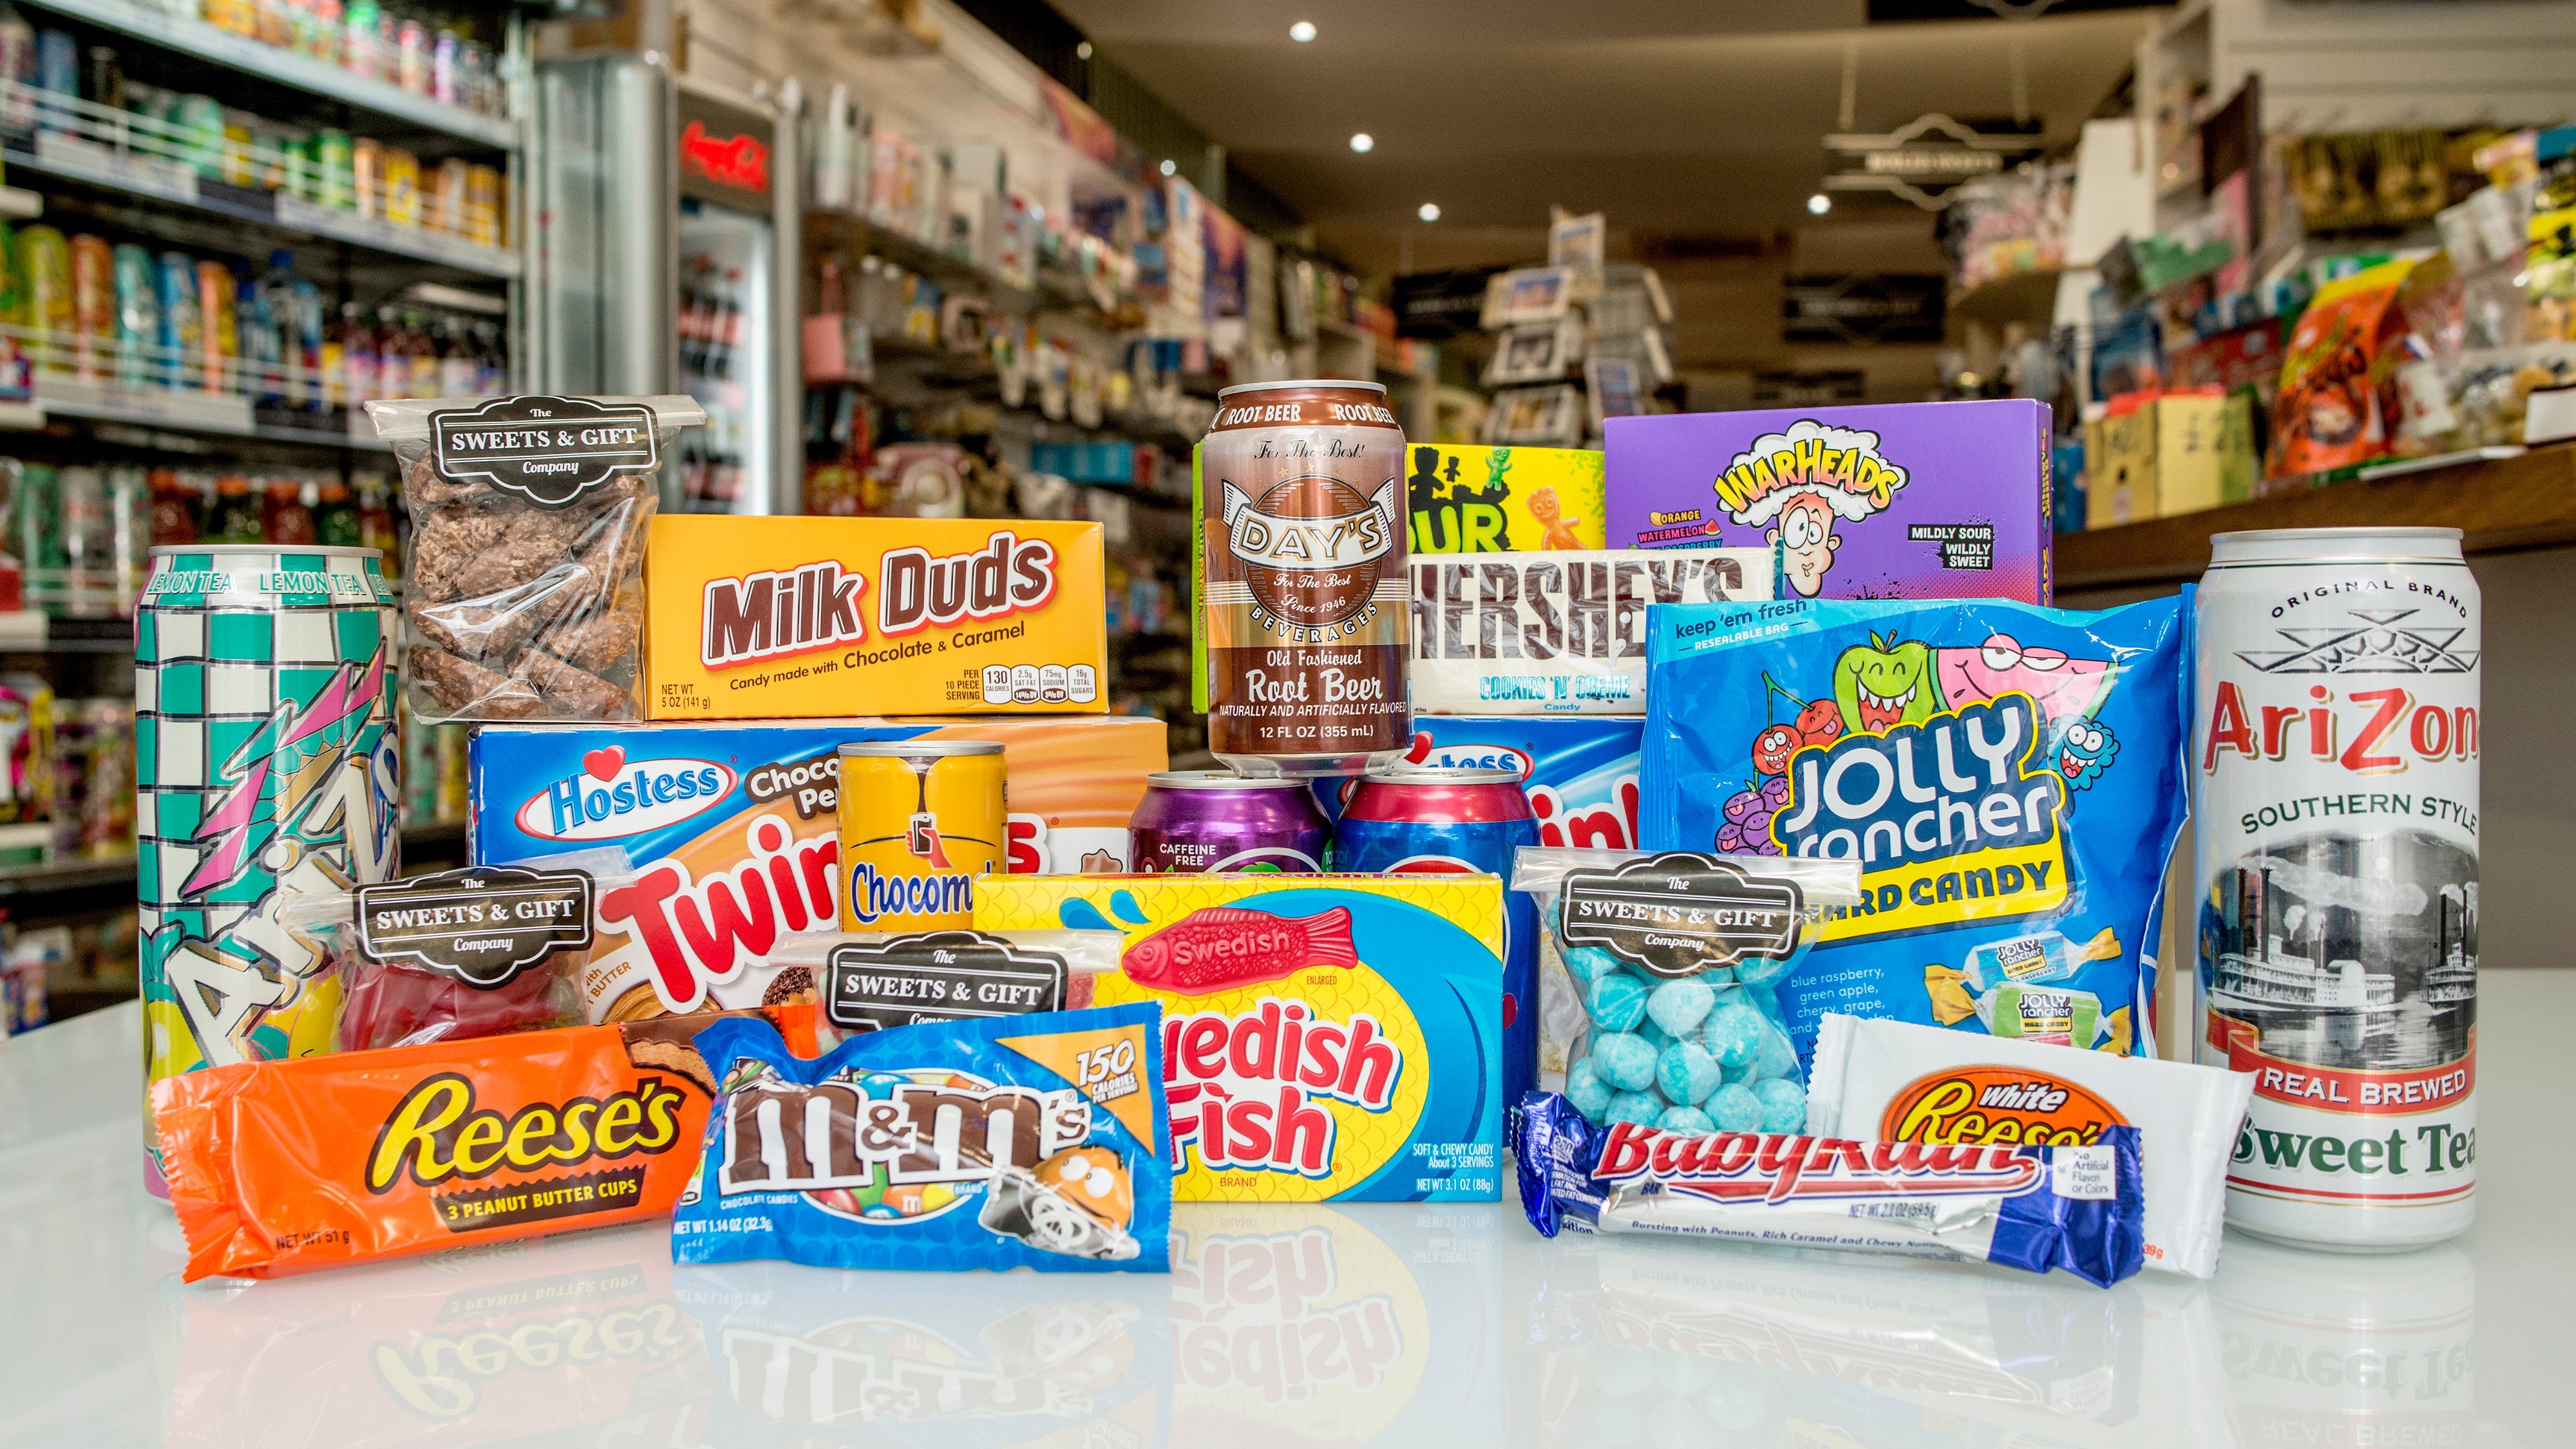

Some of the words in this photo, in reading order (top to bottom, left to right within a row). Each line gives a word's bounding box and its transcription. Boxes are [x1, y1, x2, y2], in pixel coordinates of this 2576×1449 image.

[530, 408, 552, 417] The
[1226, 406, 1263, 425] ROOT
[1264, 404, 1301, 421] BEER
[1334, 404, 1373, 422] ROOT
[452, 431, 551, 451] SWEETS
[558, 430, 574, 446] &
[581, 427, 637, 445] GIFT
[522, 460, 579, 475] Company
[1713, 439, 1900, 514] WARHEADS
[1661, 510, 1700, 524] ORANGE
[1238, 513, 1383, 562] DAY'S
[1638, 525, 1705, 543] WATERMELON
[1911, 527, 1956, 539] MILDLY
[1959, 527, 1991, 540] SOUR
[1946, 544, 1991, 555] WILDLY
[1949, 556, 1991, 567] SWEET
[147, 571, 198, 594] LEMON
[200, 572, 236, 594] TEA
[259, 571, 332, 594] LEMON
[331, 573, 366, 596] TEA
[1273, 573, 1294, 587] For
[1297, 574, 1320, 588] The
[1324, 573, 1351, 587] Best
[704, 563, 864, 663] Milk
[882, 534, 1052, 630] Duds
[1281, 594, 1316, 613] Since
[1320, 596, 1346, 613] 1946
[2271, 580, 2394, 618] ORIGINAL
[2408, 582, 2467, 619] BRAND
[1250, 601, 1378, 643] BEVERAGES
[1676, 620, 1716, 639] keep
[1719, 611, 1752, 627] 'em
[1758, 600, 1807, 620] fresh
[1694, 628, 1763, 650] RESEALABLE
[1765, 622, 1789, 635] BAG
[730, 674, 770, 690] Candy
[773, 667, 809, 683] made
[813, 660, 838, 675] with
[843, 641, 932, 670] Chocolate
[938, 641, 947, 652] &
[952, 621, 1025, 649] Caramel
[1267, 649, 1291, 667] Old
[1297, 649, 1362, 667] Fashioned
[964, 670, 979, 678] PER
[987, 670, 1008, 684] 130
[1018, 670, 1032, 679] 2.5g
[1045, 669, 1062, 678] 75mg
[1076, 669, 1087, 678] 16g
[661, 684, 678, 694] NET
[681, 684, 694, 694] WT
[945, 681, 954, 689] 10
[957, 680, 980, 689] PIECE
[1245, 669, 1309, 703] Root
[1320, 668, 1383, 702] Beer
[1481, 677, 1546, 701] COOKIES
[1576, 676, 1630, 700] CREME
[669, 697, 681, 707] OZ
[946, 691, 980, 700] SERVING
[1220, 705, 1267, 717] NATURALLY
[1269, 705, 1294, 717] AND
[1296, 704, 1367, 716] ARTIFICIALLY
[1369, 701, 1406, 715] FLAVORED
[1544, 703, 1581, 712] Candy
[1260, 726, 1274, 737] 12
[1278, 726, 1291, 737] FL
[1296, 726, 1316, 737] OZ
[1320, 725, 1348, 738] (355
[1352, 724, 1374, 737] mL)
[1786, 708, 2021, 833] JOLLY
[547, 766, 720, 836] Hostess
[1798, 786, 2047, 862] rancher
[2242, 793, 2411, 835] SOUTHERN
[2421, 796, 2477, 837] STYLE
[1160, 843, 1216, 855] CAFFEINE
[1175, 855, 1204, 866] FREE
[461, 878, 485, 889] The
[1667, 876, 1690, 890] The
[1909, 860, 2052, 905] CANDY
[377, 905, 481, 930] SWEETS
[491, 903, 509, 921] &
[516, 900, 574, 919] GIFT
[1579, 901, 1680, 923] SWEETS
[1688, 909, 1707, 925] &
[1714, 911, 1777, 927] GIFT
[454, 938, 513, 953] Company
[1175, 931, 1289, 965] Swedish
[1645, 933, 1705, 951] Company
[1998, 939, 2038, 959] JOLLY
[933, 950, 956, 965] The
[2003, 947, 2041, 966] rancher
[591, 961, 632, 998] BUTTER
[1306, 975, 1338, 986] ENLARGED
[1791, 976, 1817, 987] blue
[1821, 968, 1884, 984] raspberry,
[845, 974, 946, 999] SWEETS
[952, 983, 971, 1001] &
[978, 984, 1041, 1006] GIFT
[1800, 989, 1834, 1005] green
[1839, 983, 1878, 998] apple,
[1844, 1000, 1885, 1014] grape,
[2021, 995, 2070, 1008] JOLLY
[2023, 1007, 2069, 1017] rancher
[1077, 1038, 1135, 1087] 150
[1092, 1072, 1135, 1095] CALORIES
[2264, 1067, 2349, 1104] REAL
[2360, 1070, 2466, 1106] BREWED
[1979, 1082, 2066, 1112] White
[368, 1075, 684, 1191] Reese's
[1166, 1083, 1332, 1171] Fish
[1413, 1144, 1431, 1155] SOFT
[1433, 1144, 1439, 1155] &
[1441, 1144, 1467, 1155] CHEWY
[1469, 1144, 1494, 1155] CANDY
[1429, 1156, 1449, 1168] About
[1459, 1157, 1494, 1168] SERVINGS
[2072, 1160, 2109, 1171] Artificial
[1220, 1177, 1257, 1188] BRAND
[1417, 1179, 1431, 1191] NET
[1432, 1179, 1444, 1191] WT
[1446, 1179, 1457, 1191] 3.1
[1460, 1179, 1470, 1191] OZ
[1473, 1178, 1494, 1193] (88g)
[2084, 1182, 2109, 1193] Colors
[448, 1205, 458, 1220] 3
[463, 1195, 527, 1218] PEANUT
[533, 1185, 594, 1208] BUTTER
[598, 1179, 638, 1198] CUPS
[276, 1235, 298, 1250] NET
[325, 1230, 339, 1244] 51
[1632, 1220, 1678, 1233] Bursting
[1682, 1224, 1707, 1235] with
[1763, 1230, 1786, 1240] Rich
[1791, 1233, 1837, 1244] Caramel
